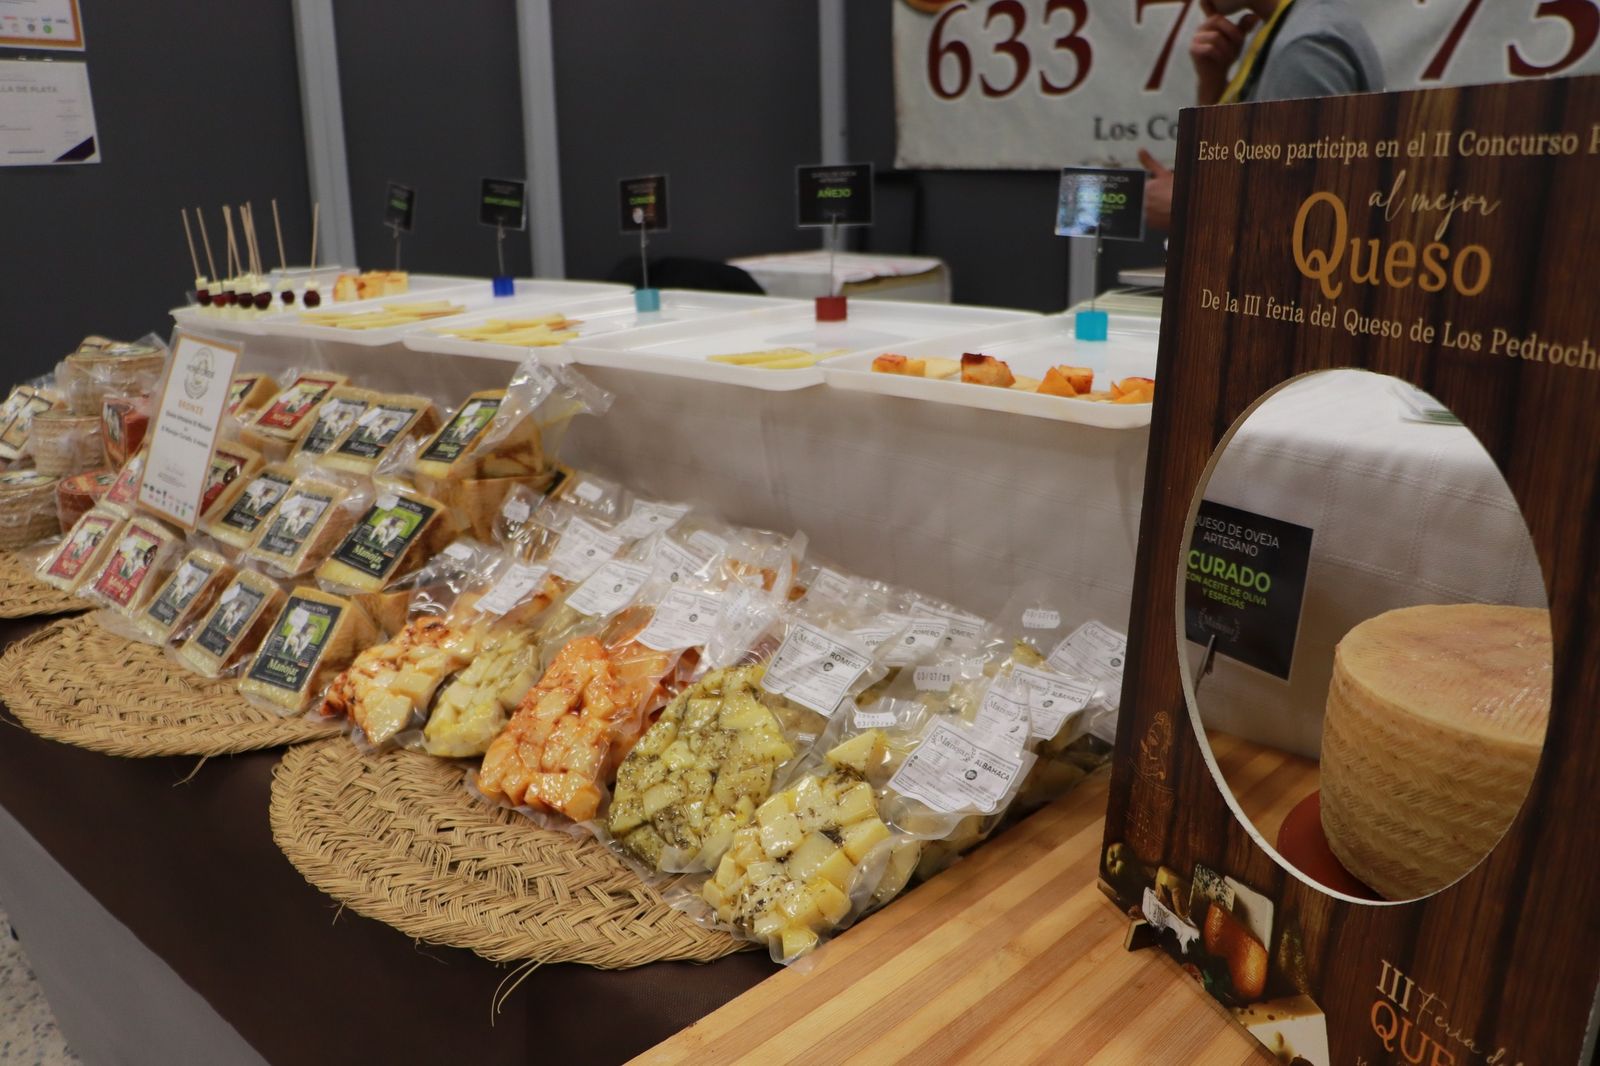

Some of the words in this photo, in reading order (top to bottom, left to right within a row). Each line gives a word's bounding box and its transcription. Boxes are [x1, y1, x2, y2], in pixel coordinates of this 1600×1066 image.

[926, 0, 1094, 101] 633
[1094, 116, 1139, 142] Los
[1198, 140, 1229, 161] Este
[1233, 139, 1281, 164] Queso
[1285, 135, 1369, 166] participa
[1375, 140, 1399, 159] en
[1406, 133, 1426, 158] el
[1433, 131, 1452, 157] II
[1458, 130, 1579, 157] Concurso
[817, 186, 851, 199] AÑEJO
[1368, 169, 1408, 222] al
[1410, 188, 1501, 242] mejor
[1293, 191, 1493, 299] Queso
[1201, 288, 1221, 310] De
[1224, 291, 1239, 313] la
[1243, 294, 1261, 317] III
[1265, 296, 1305, 324] feria
[1310, 304, 1337, 329] del
[1343, 308, 1403, 340] Queso
[1409, 317, 1436, 344] de
[1441, 320, 1483, 352] Los
[1489, 327, 1600, 371] Pedroch
[1195, 516, 1226, 533] UESO
[1227, 523, 1243, 538] DE
[1244, 528, 1280, 549] OVEJA
[1203, 531, 1259, 557] ARTESANO
[1187, 549, 1271, 593] CURADO
[1202, 577, 1230, 592] ACEITE
[1242, 591, 1267, 607] OLIVA
[1208, 590, 1247, 610] ESPECIAS
[266, 658, 300, 679] Manojar
[830, 651, 862, 669] ROMERO
[974, 758, 1011, 781] ALBAHACA
